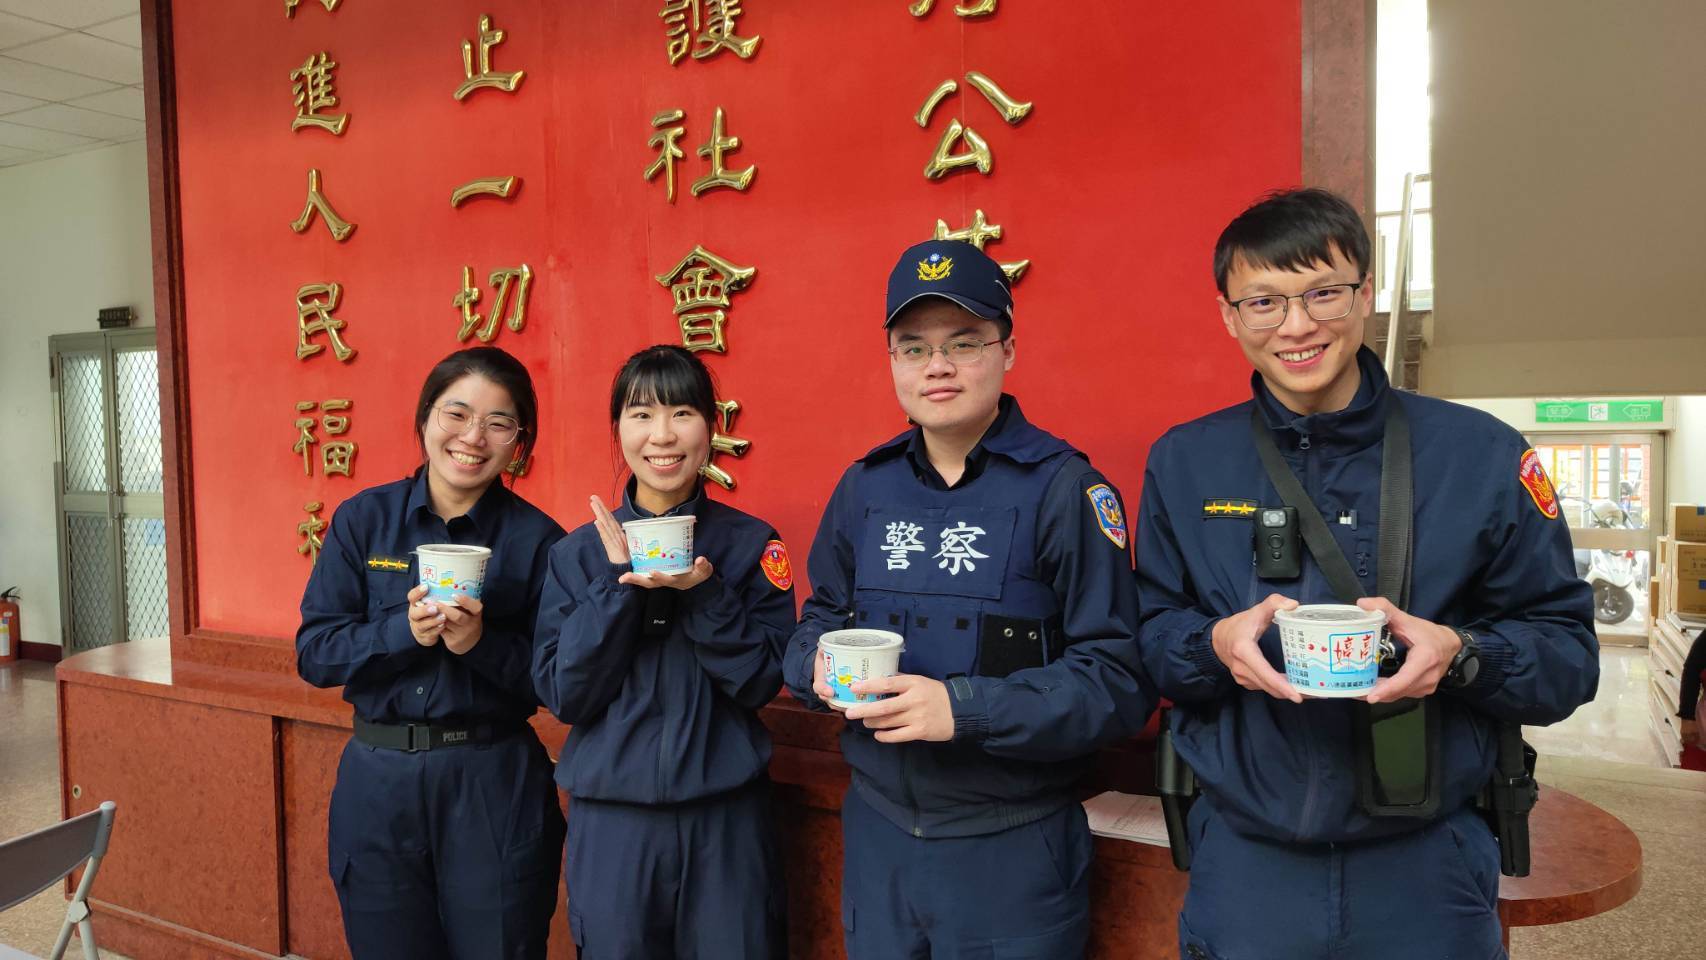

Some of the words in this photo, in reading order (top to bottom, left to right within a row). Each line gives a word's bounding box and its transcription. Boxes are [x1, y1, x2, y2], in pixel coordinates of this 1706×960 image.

[289, 0, 355, 569] 進人民福
[880, 521, 990, 575] 警察
